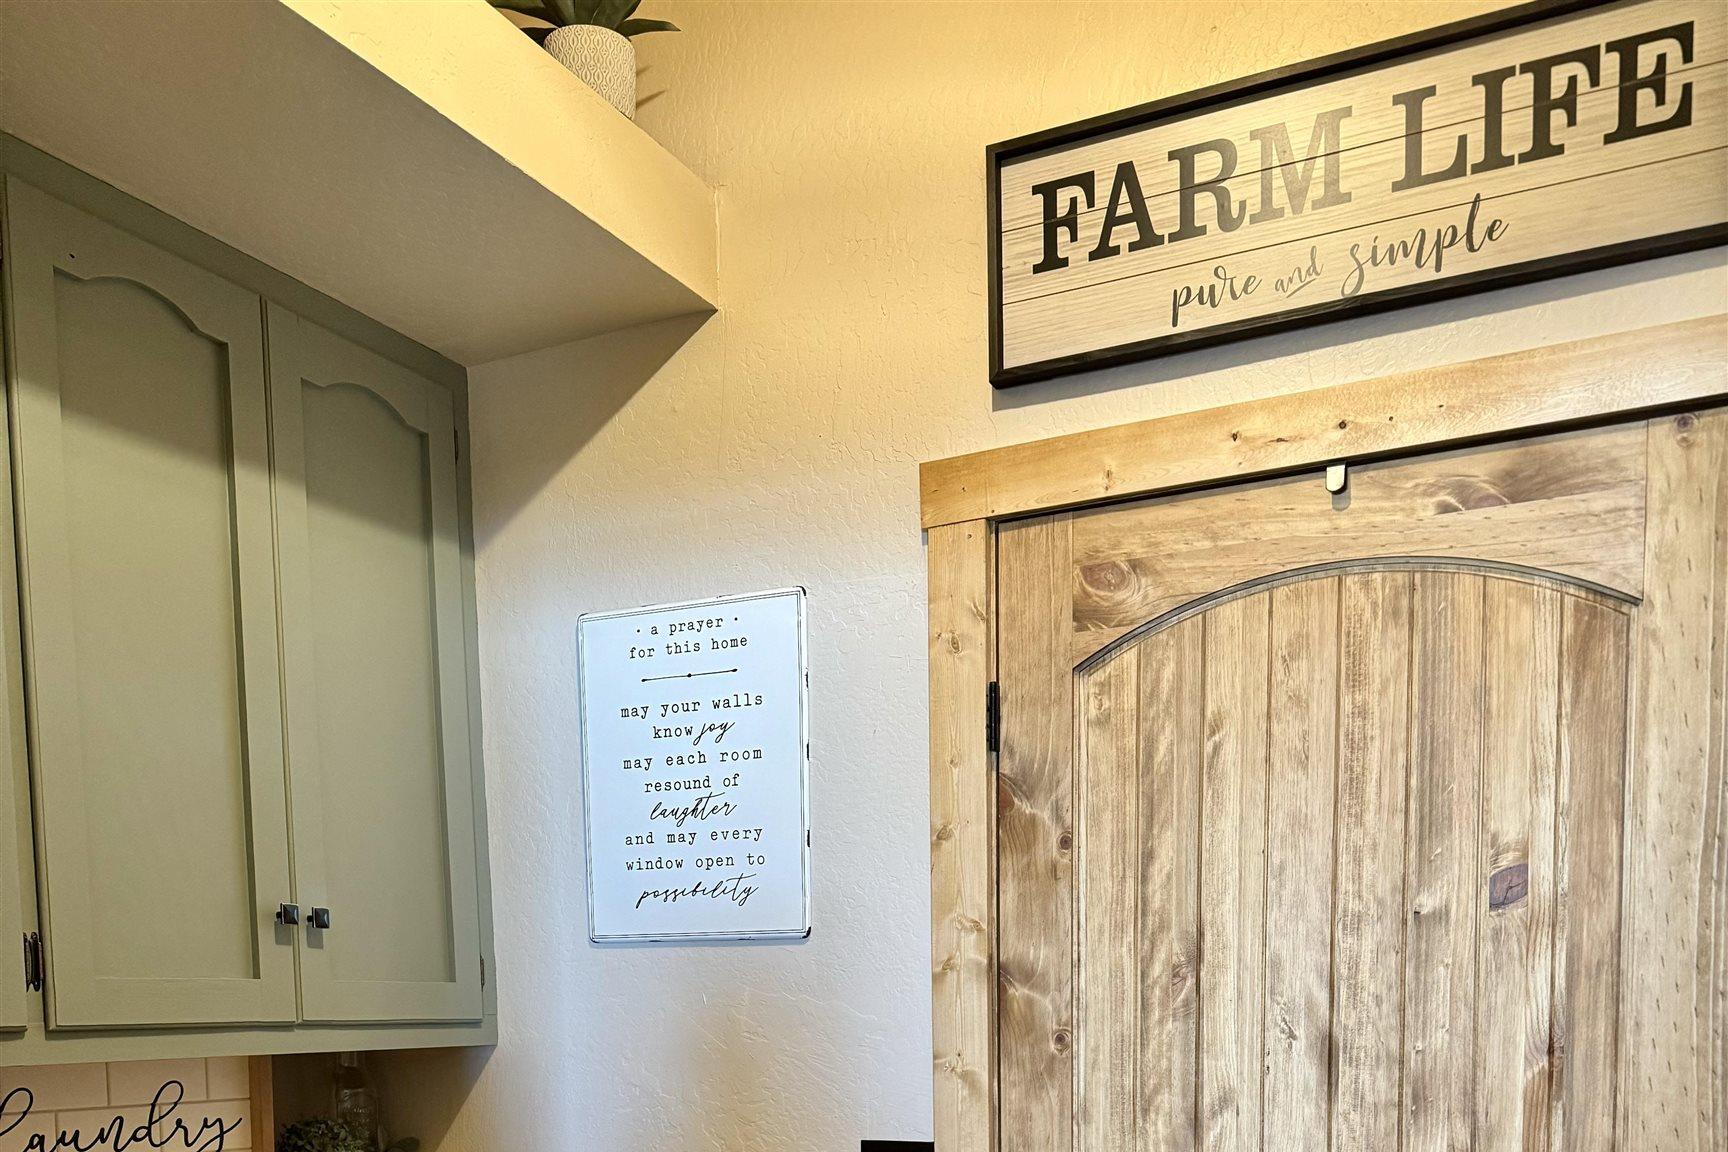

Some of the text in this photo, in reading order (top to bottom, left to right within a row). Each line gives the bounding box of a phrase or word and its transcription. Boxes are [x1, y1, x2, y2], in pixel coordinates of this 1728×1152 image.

[1031, 20, 1695, 274] FARM LIFE
[1171, 193, 1510, 327] pure and simple
[651, 617, 724, 636] a prayer
[629, 636, 748, 659] for this home
[621, 693, 763, 719] may your walls
[653, 721, 736, 746] know joy
[623, 748, 763, 771] may each room
[645, 773, 740, 793] resound of
[650, 791, 738, 827] laughter
[625, 827, 763, 846] and may every
[626, 853, 766, 872] window open to
[635, 873, 760, 909] possibility
